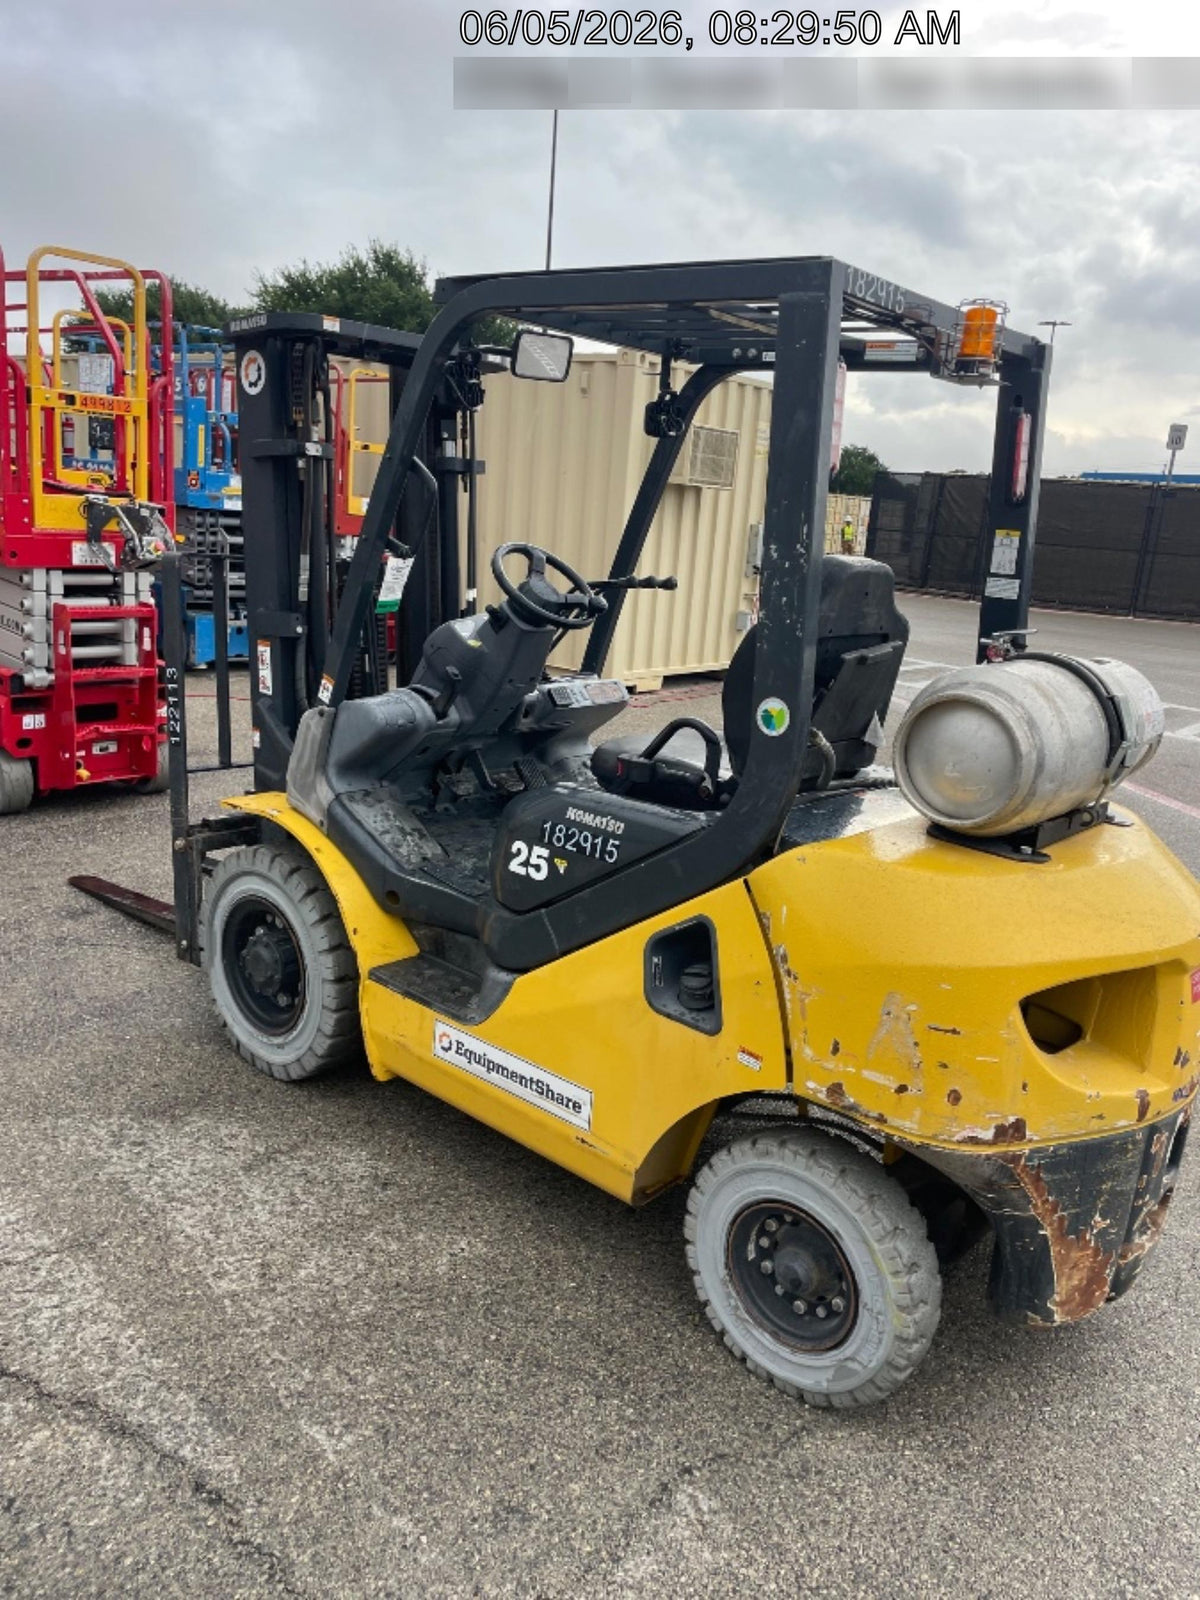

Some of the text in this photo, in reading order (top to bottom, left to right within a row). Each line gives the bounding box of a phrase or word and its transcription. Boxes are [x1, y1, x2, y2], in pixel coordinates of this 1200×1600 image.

[846, 266, 905, 314] 182915
[80, 395, 131, 413] 499812
[166, 667, 181, 744] 122113
[543, 820, 621, 864] 182915
[565, 806, 625, 835] KOMATSU
[508, 840, 550, 881] 25
[454, 1039, 583, 1114] EquipmentShare
